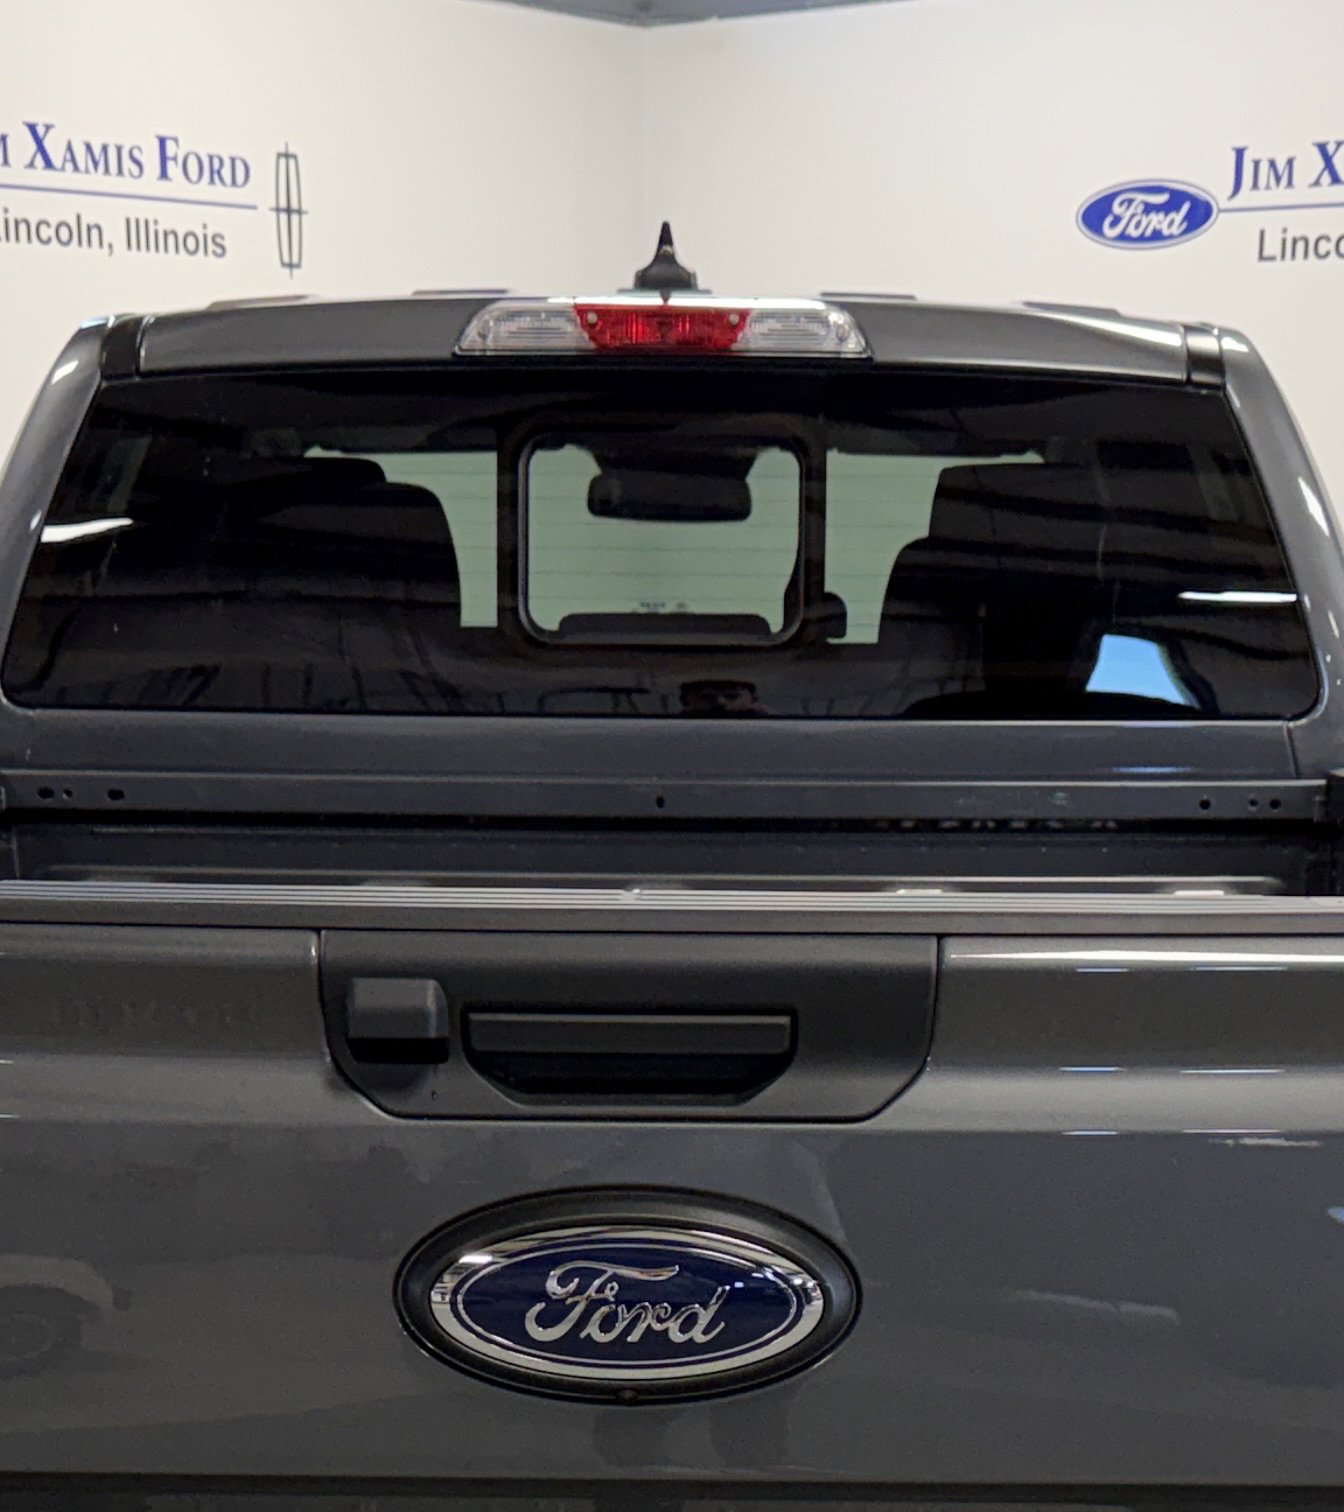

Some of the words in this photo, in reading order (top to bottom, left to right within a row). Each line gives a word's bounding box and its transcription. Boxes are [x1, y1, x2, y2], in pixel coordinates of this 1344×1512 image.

[22, 120, 145, 180] XAMIS
[155, 134, 251, 189] FORD
[1228, 145, 1296, 201] JIM
[125, 216, 227, 259] Illinois
[1102, 191, 1189, 239] Ford
[524, 1258, 732, 1345] Ford
